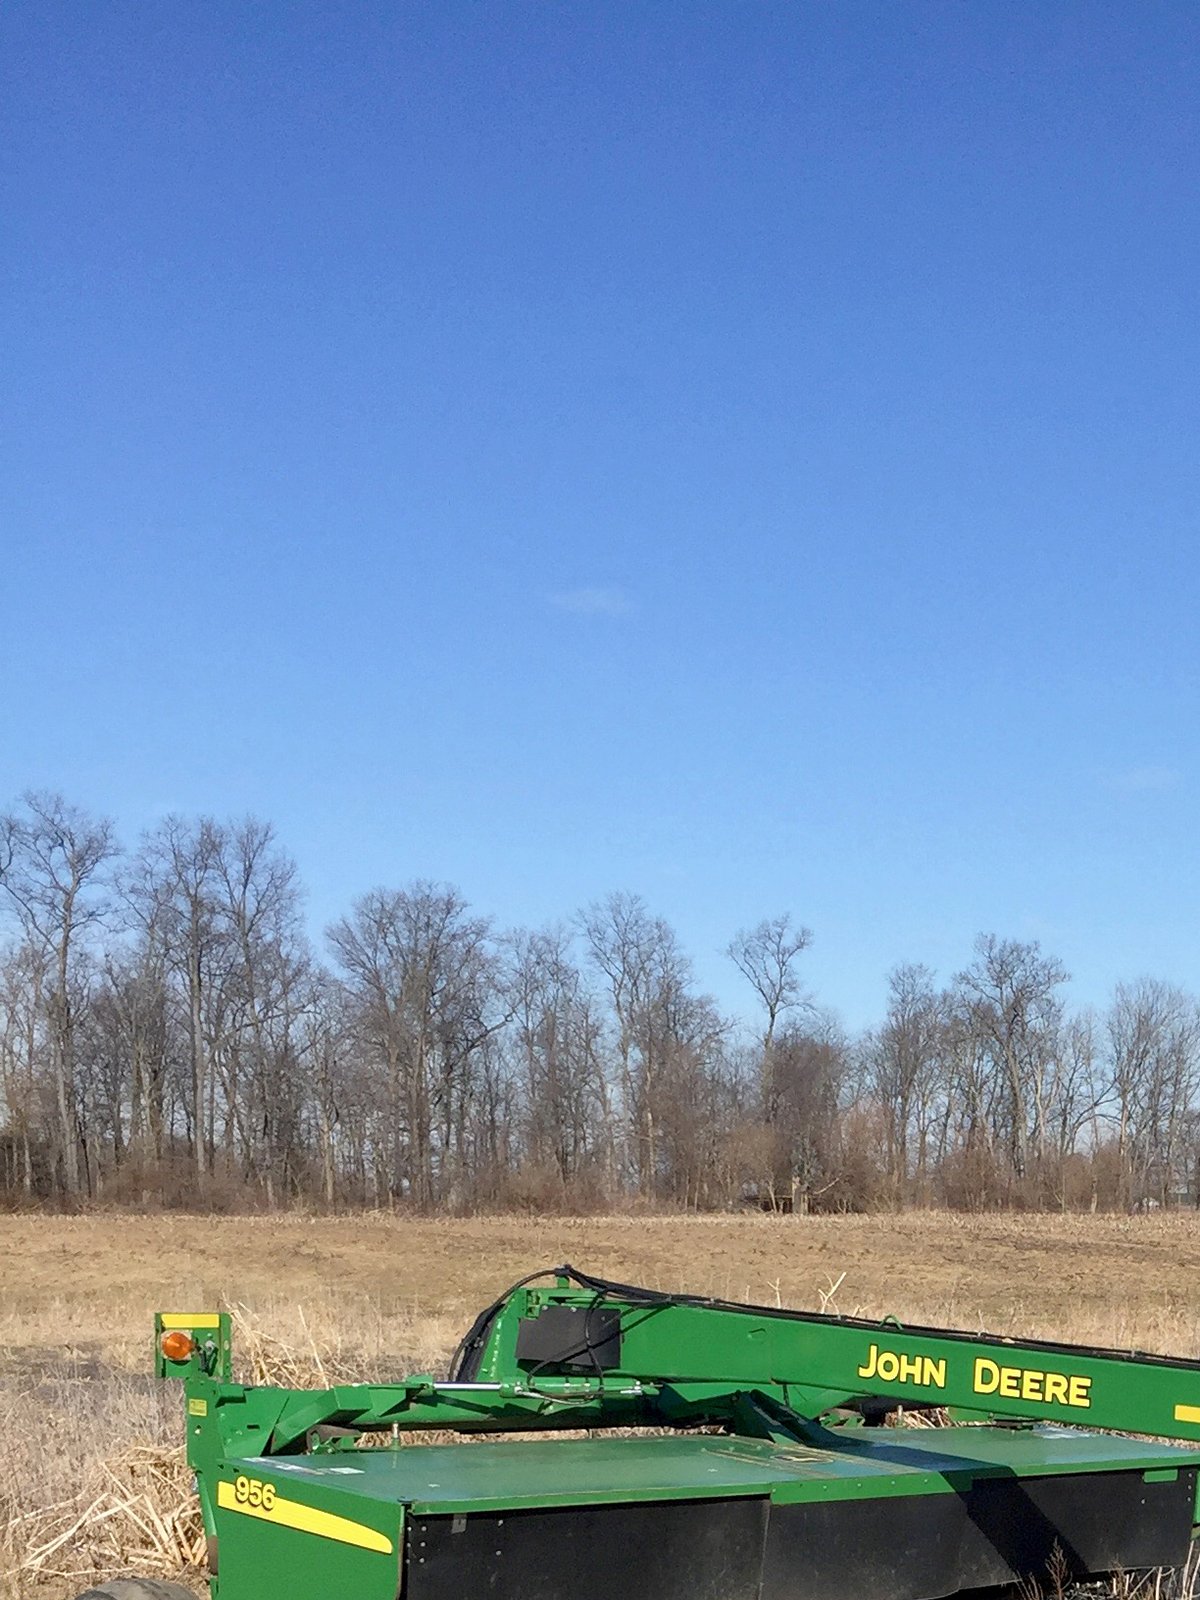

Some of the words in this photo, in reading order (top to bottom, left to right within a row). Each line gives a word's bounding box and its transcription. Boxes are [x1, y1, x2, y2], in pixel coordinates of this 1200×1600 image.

[857, 1345, 946, 1388] JOHN
[973, 1358, 1092, 1408] DEERE
[234, 1475, 277, 1512] 956
